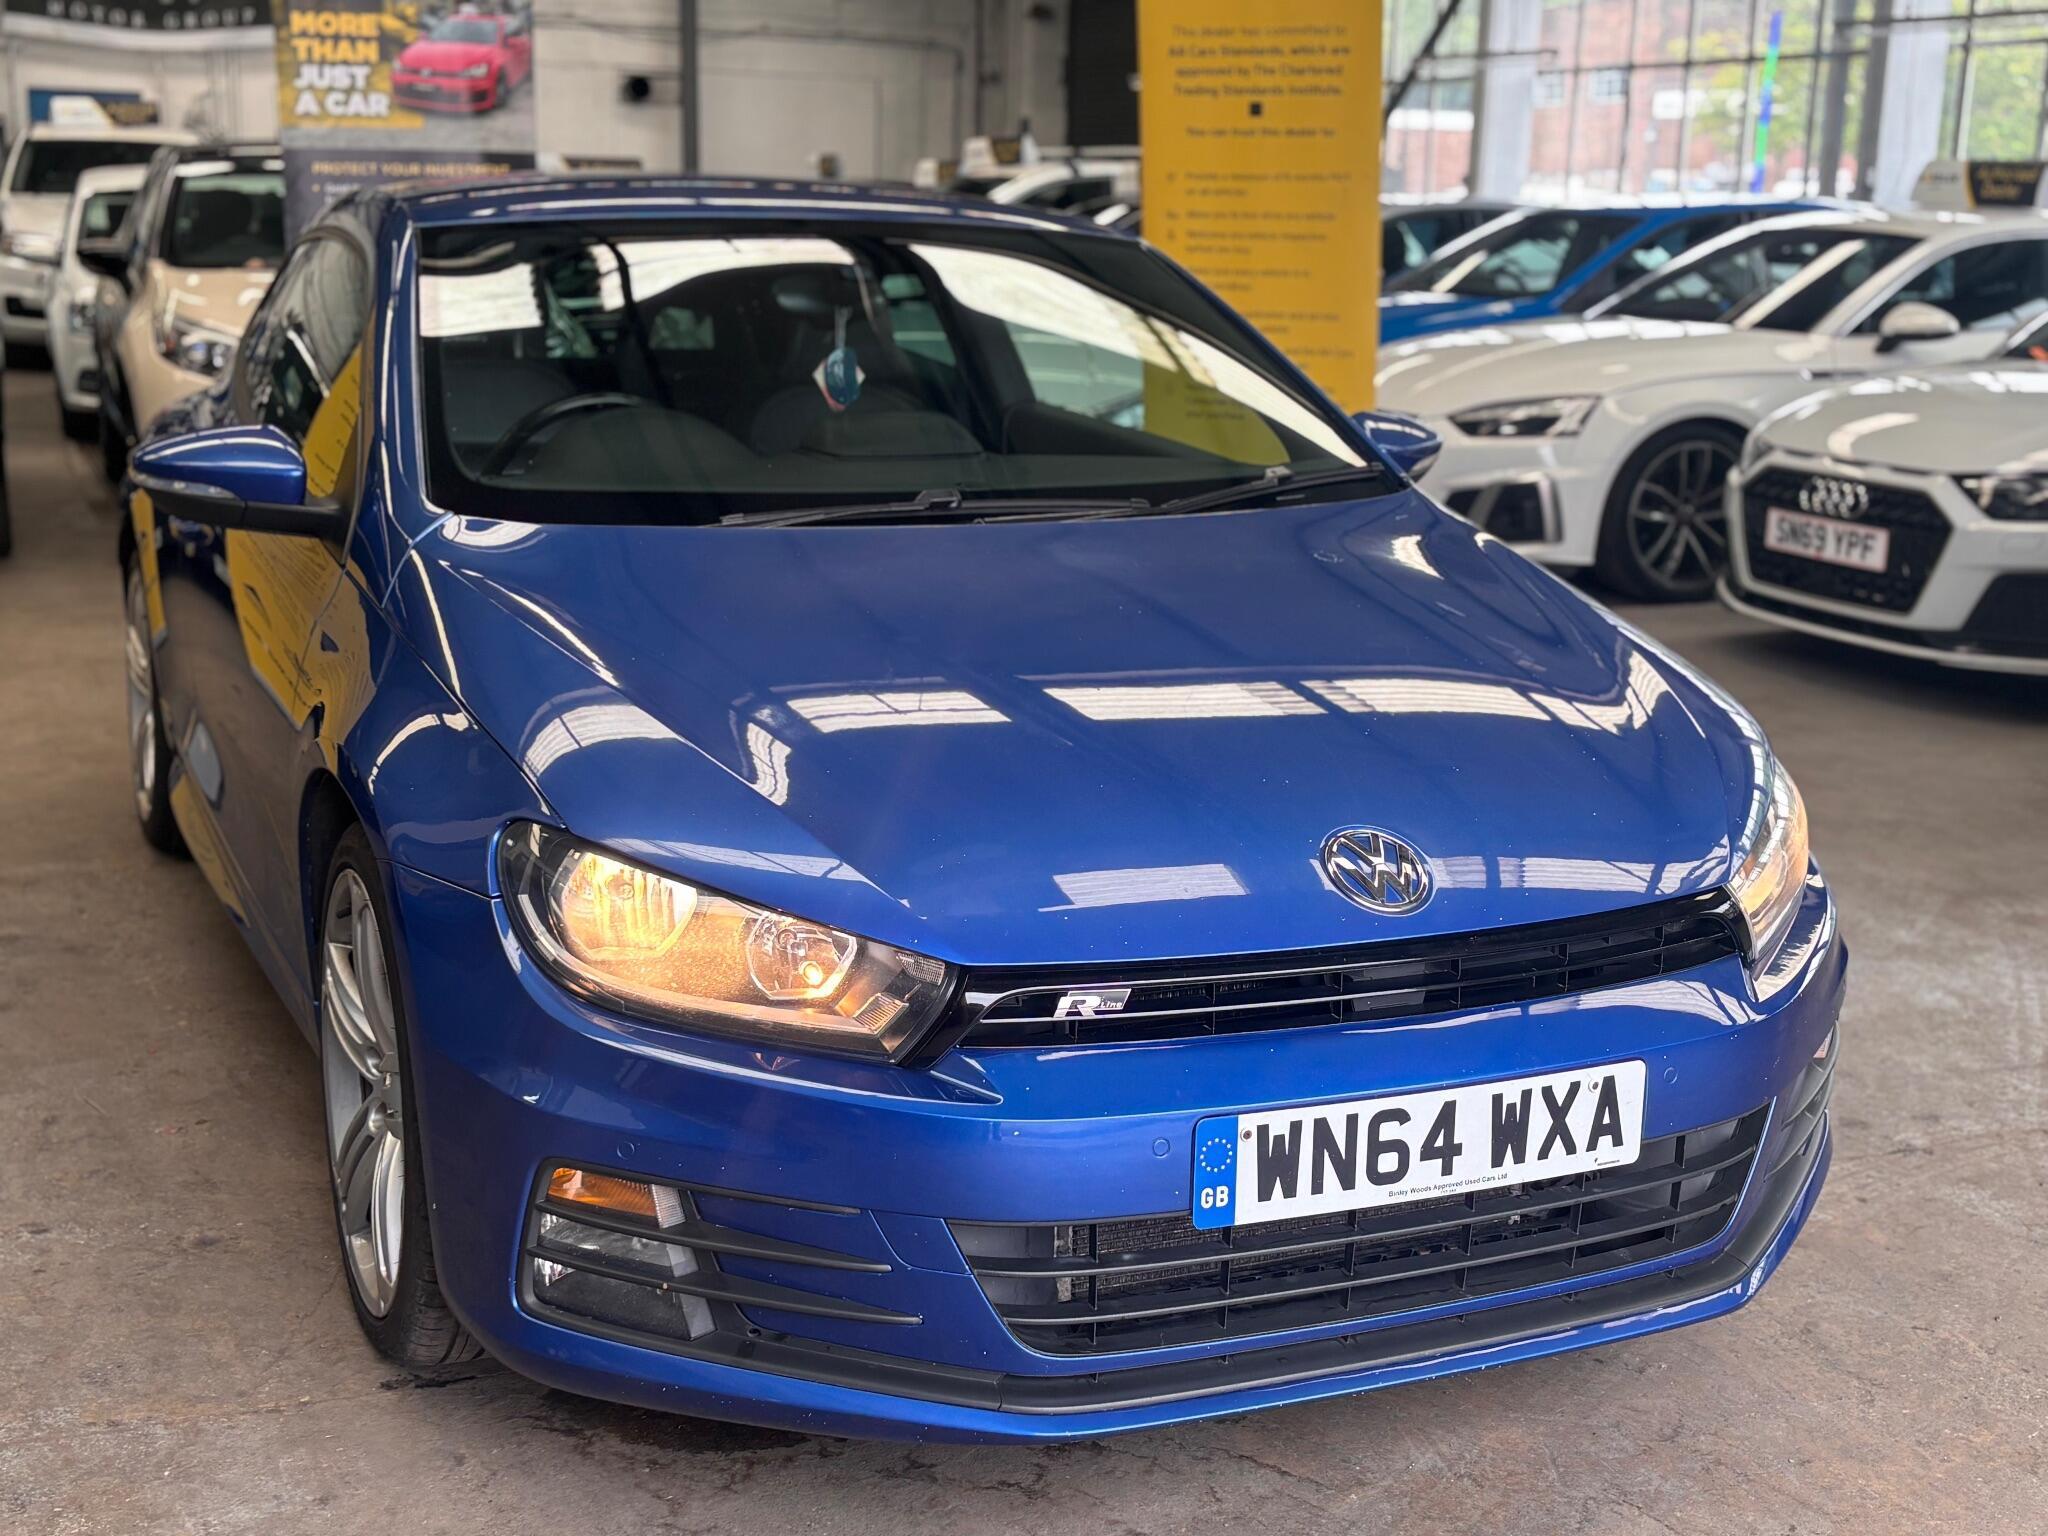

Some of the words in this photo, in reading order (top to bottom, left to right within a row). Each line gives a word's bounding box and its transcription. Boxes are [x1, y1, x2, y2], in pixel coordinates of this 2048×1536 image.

[163, 9, 257, 30] GROUP
[290, 9, 380, 37] MORE
[290, 38, 379, 63] THAN
[294, 64, 371, 89] JUST
[294, 91, 321, 115] A
[324, 91, 391, 117] CAR
[311, 161, 378, 176] PROTECT
[382, 162, 422, 177] YOUR
[424, 163, 511, 177] INVESTMENT
[1834, 527, 1876, 560] YPF
[1053, 995, 1101, 1018] R
[1256, 1100, 1463, 1203] WN64
[1491, 1075, 1624, 1168] WXA
[1200, 1185, 1229, 1209] GB
[1388, 1189, 1408, 1197] Binley
[1410, 1185, 1432, 1194] Woods
[1433, 1180, 1464, 1191] Approved
[1464, 1177, 1480, 1186] Used
[1481, 1175, 1496, 1183] Cars
[1497, 1172, 1508, 1180] Ltd
